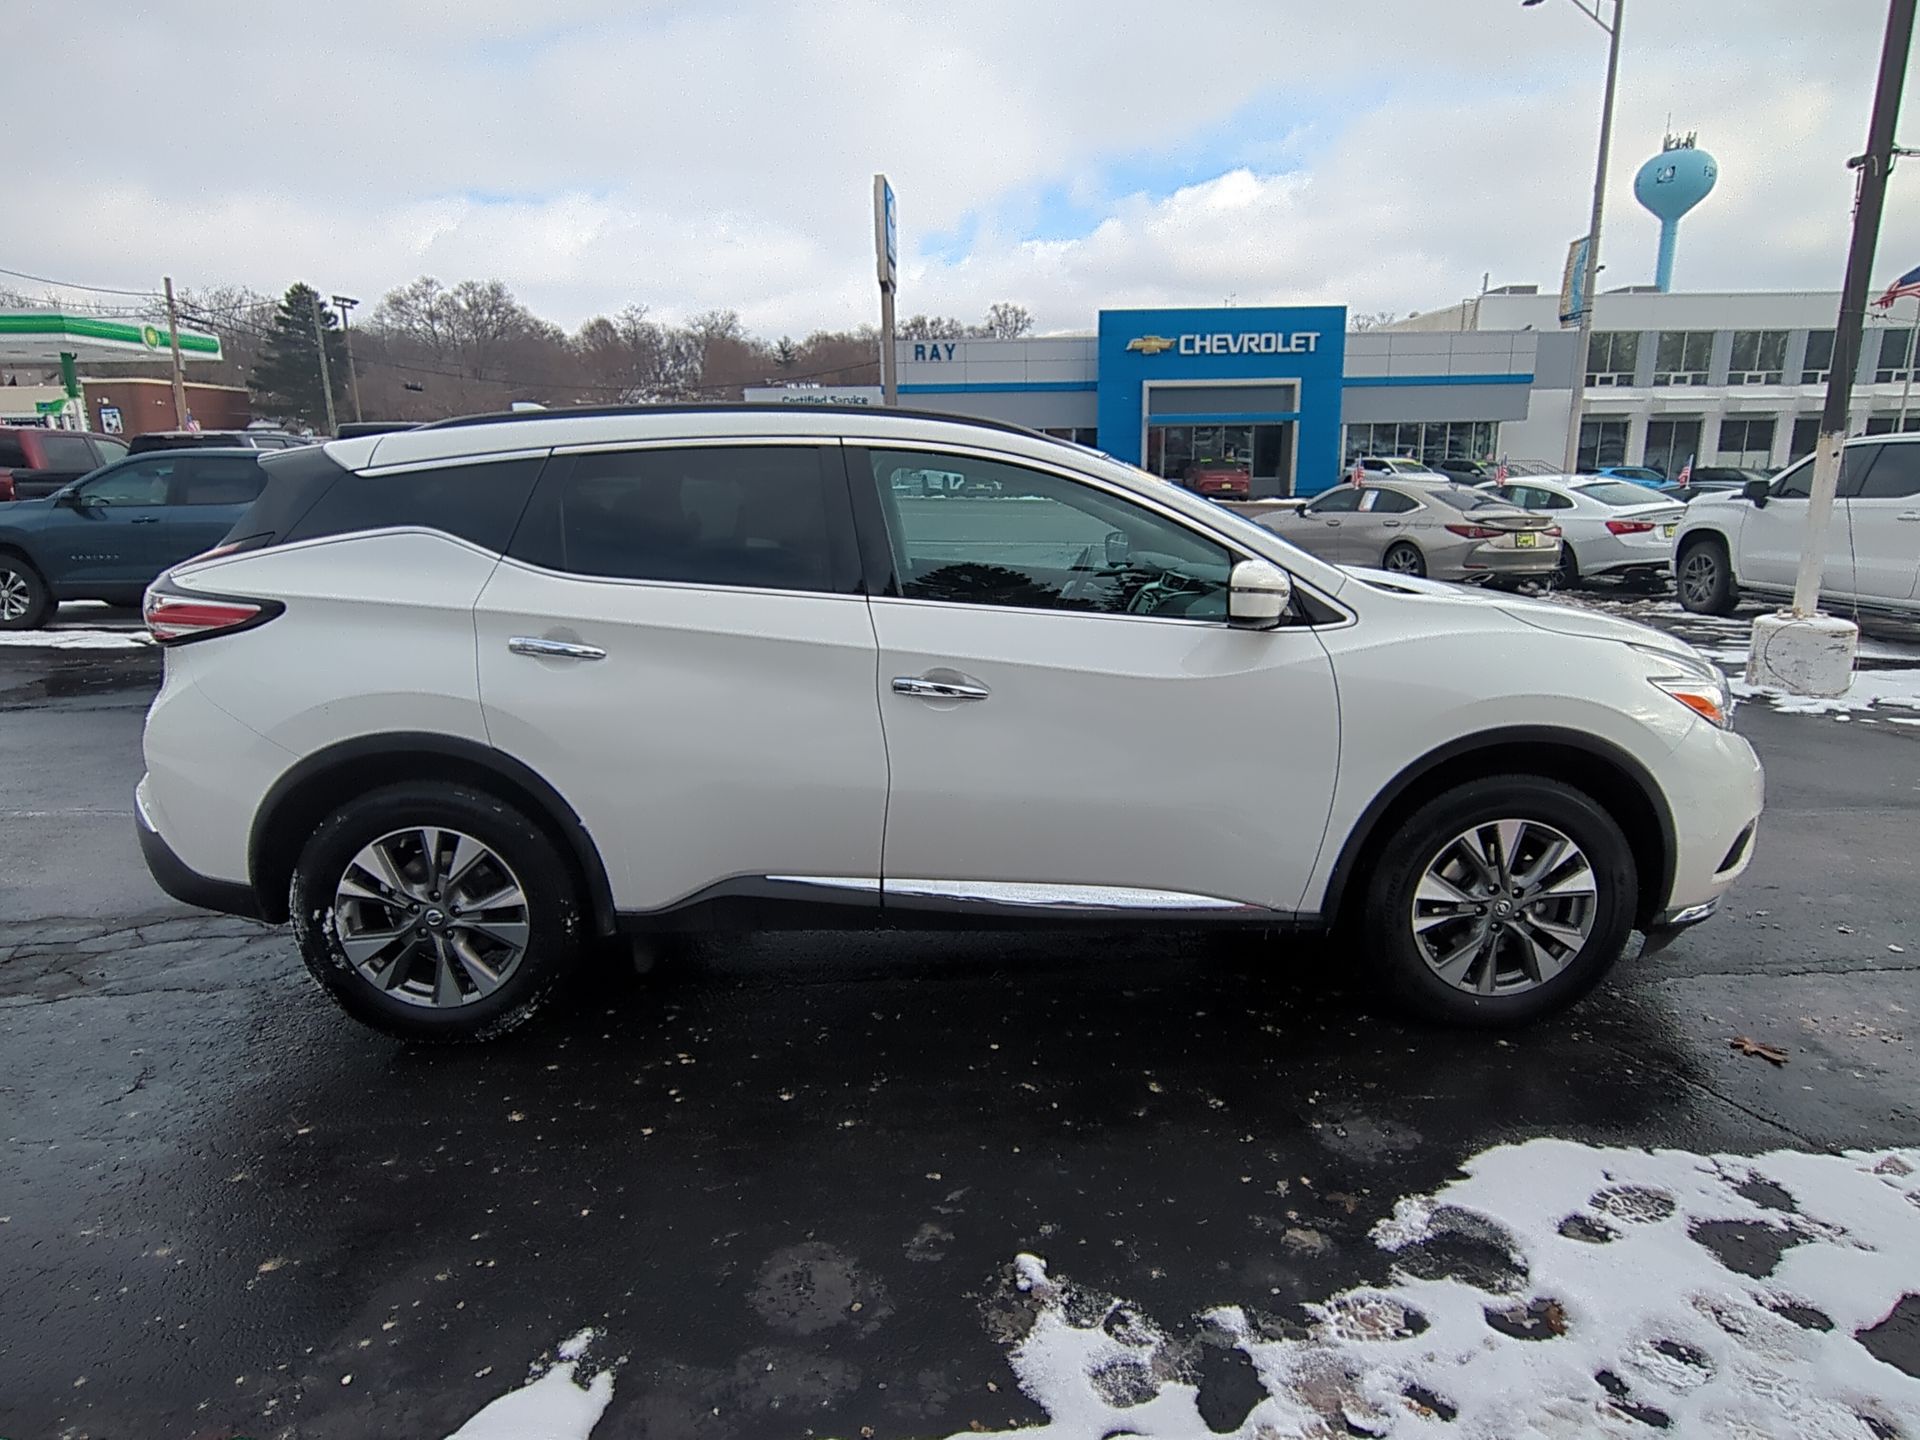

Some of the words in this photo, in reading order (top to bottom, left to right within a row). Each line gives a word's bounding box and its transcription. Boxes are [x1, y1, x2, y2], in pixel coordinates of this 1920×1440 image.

[914, 343, 956, 361] RAY
[1179, 332, 1320, 354] CHEVROLET
[782, 395, 827, 405] Certified
[830, 395, 869, 405] Service
